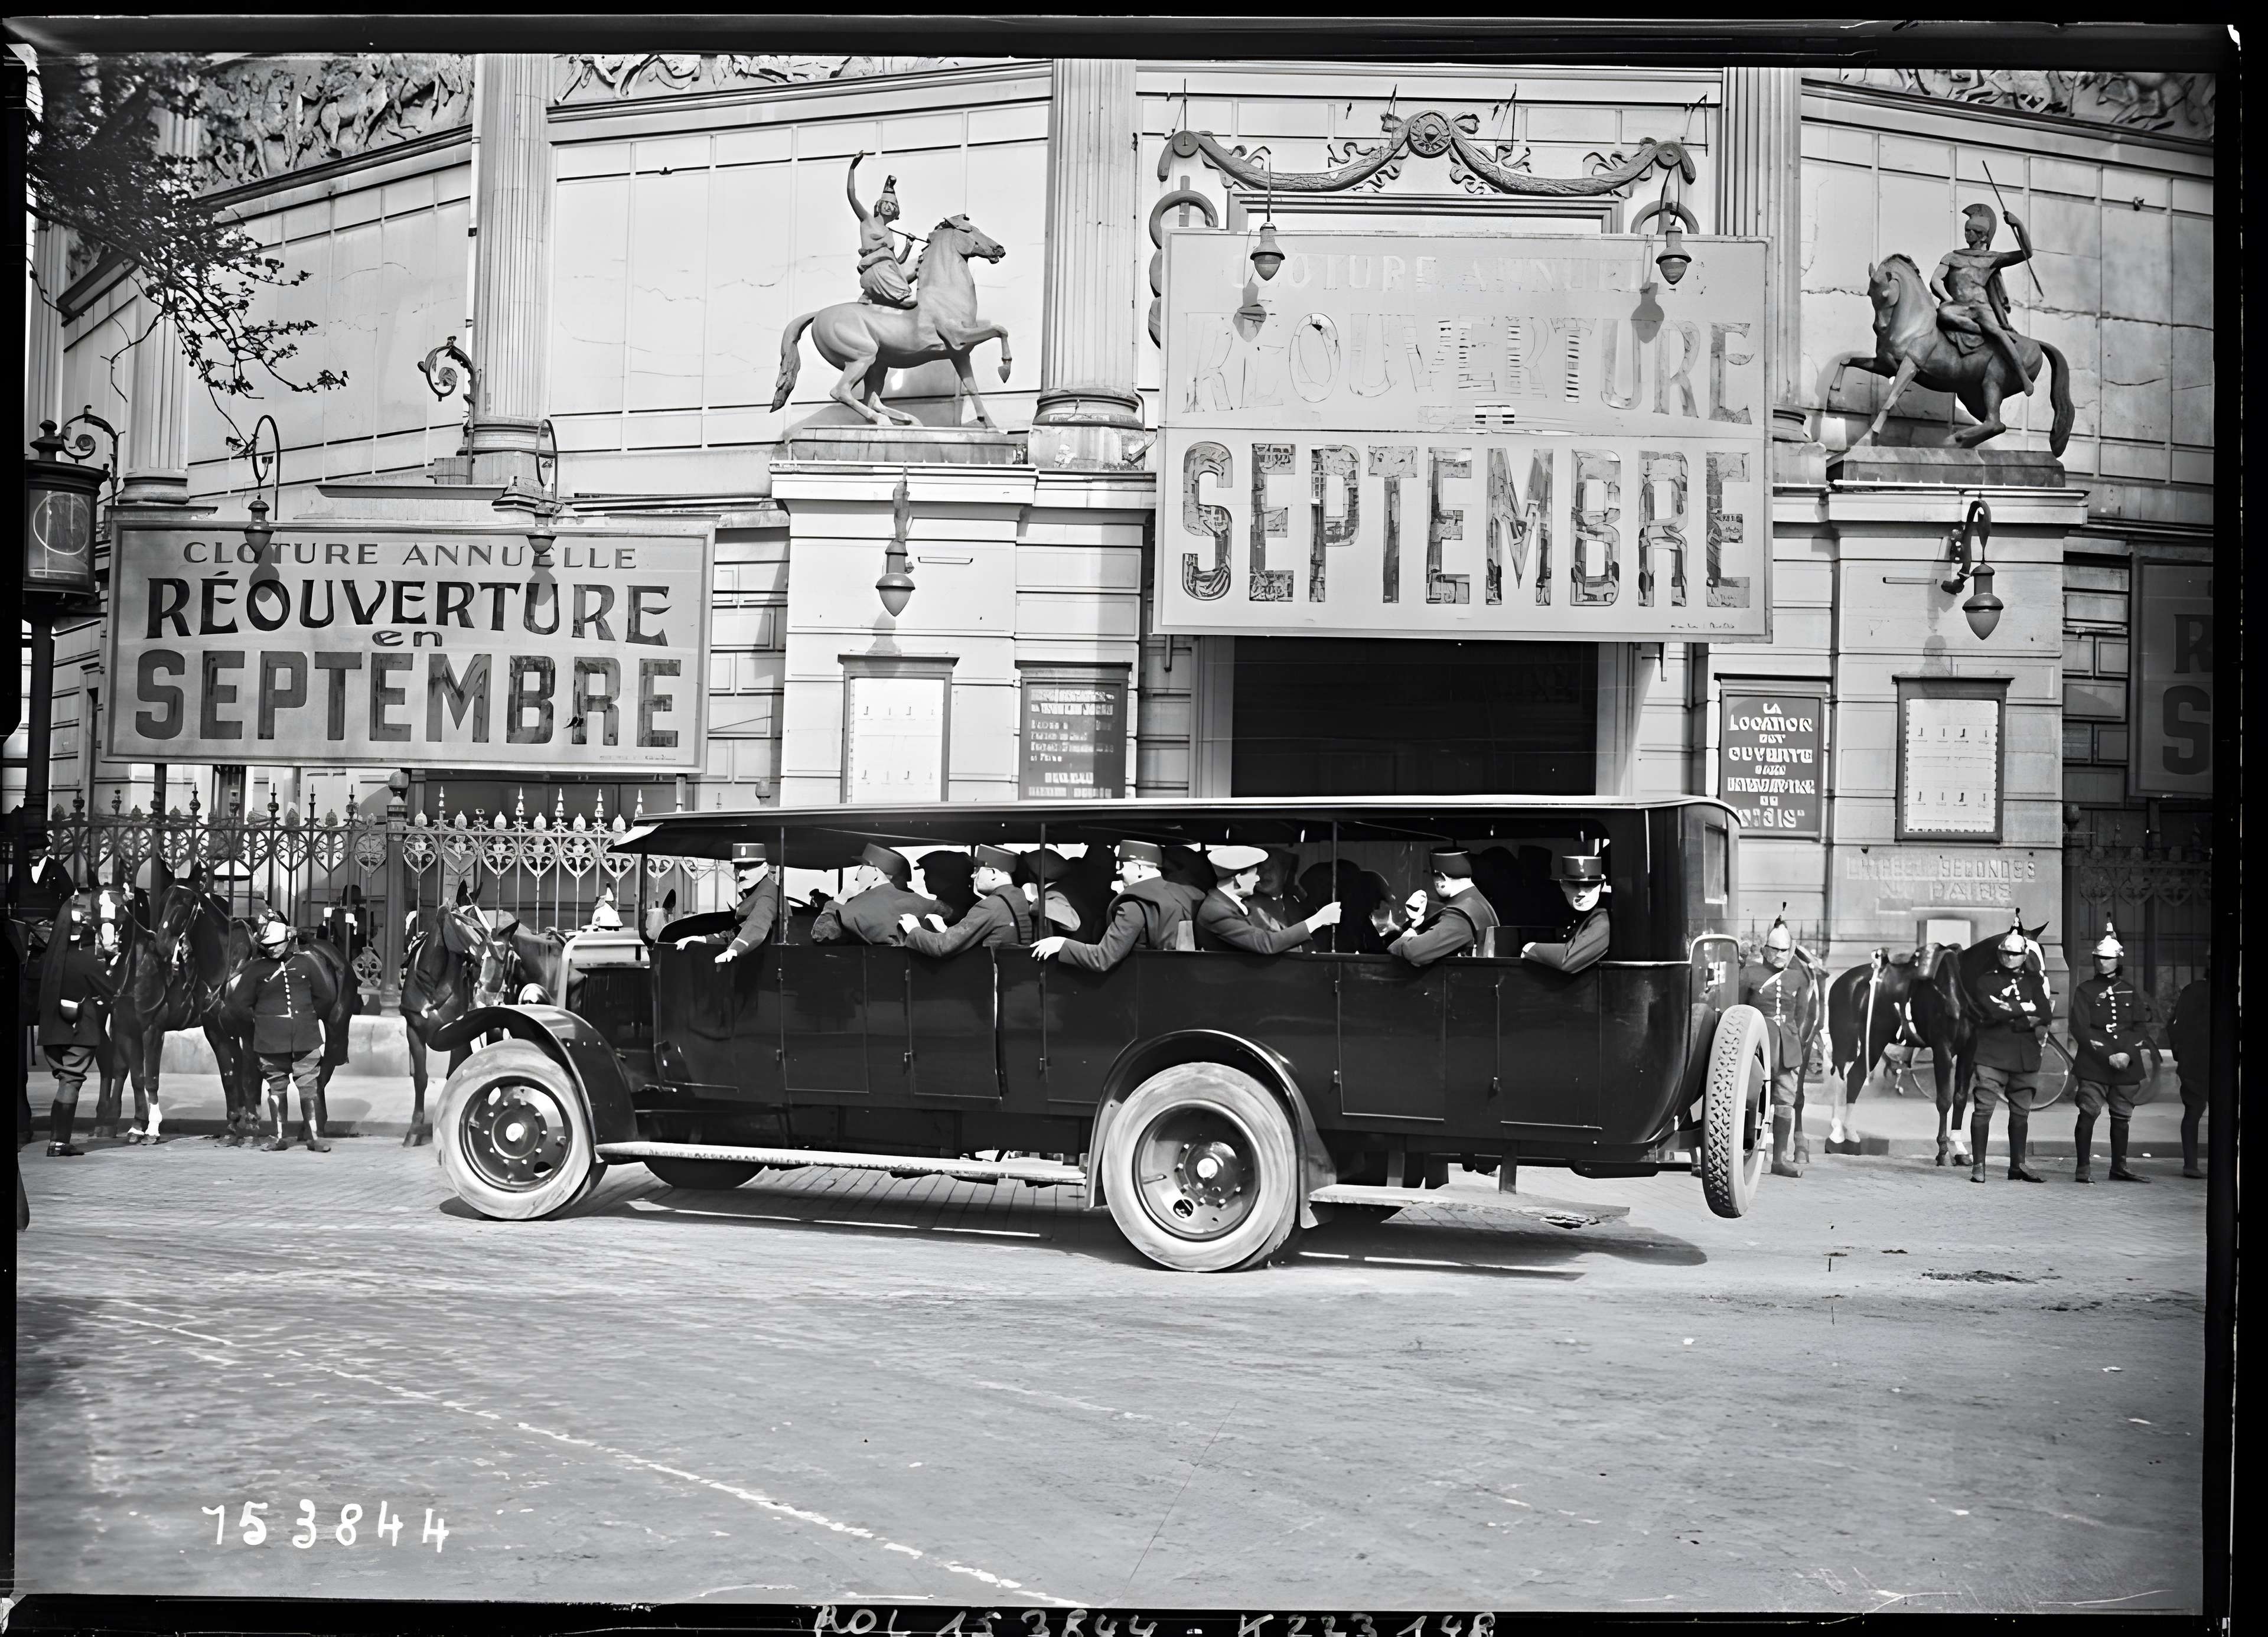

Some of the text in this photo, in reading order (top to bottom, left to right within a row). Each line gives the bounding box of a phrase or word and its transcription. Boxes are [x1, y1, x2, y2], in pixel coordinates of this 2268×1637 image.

[402, 543, 637, 569] ANNUELLE
[1181, 441, 1751, 609] SEPTEMBRE
[145, 570, 672, 647] RÉOUVERTURE
[372, 630, 443, 647] en
[135, 649, 682, 748] SEPTEMBRE
